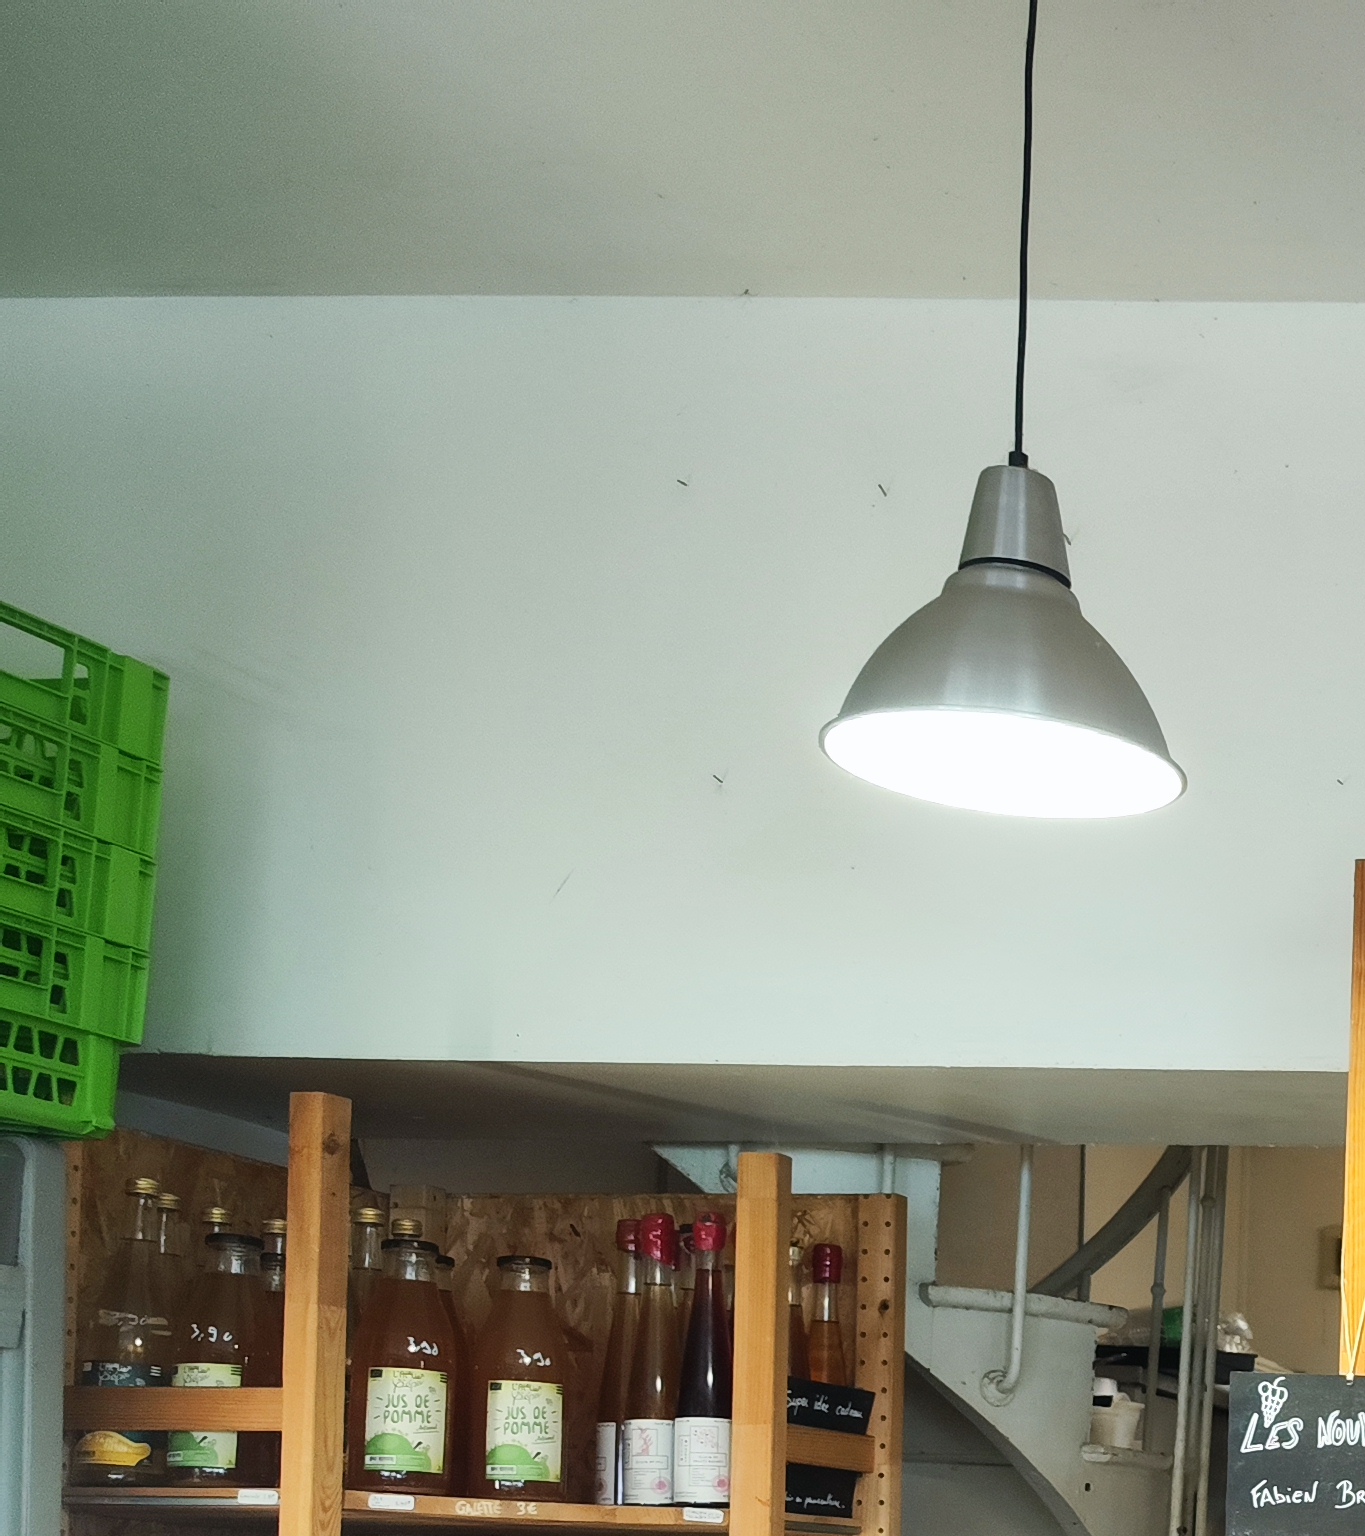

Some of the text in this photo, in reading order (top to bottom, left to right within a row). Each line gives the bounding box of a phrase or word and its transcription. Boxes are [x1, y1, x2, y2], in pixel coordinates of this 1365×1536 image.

[385, 1394, 430, 1409] JUS DE
[810, 1394, 830, 1413] idée
[383, 1409, 433, 1424] POMME
[504, 1405, 548, 1421] JUS DE
[503, 1419, 549, 1436] POMME
[1240, 1412, 1304, 1453] LES
[454, 1500, 538, 1516] GALETTE 3€
